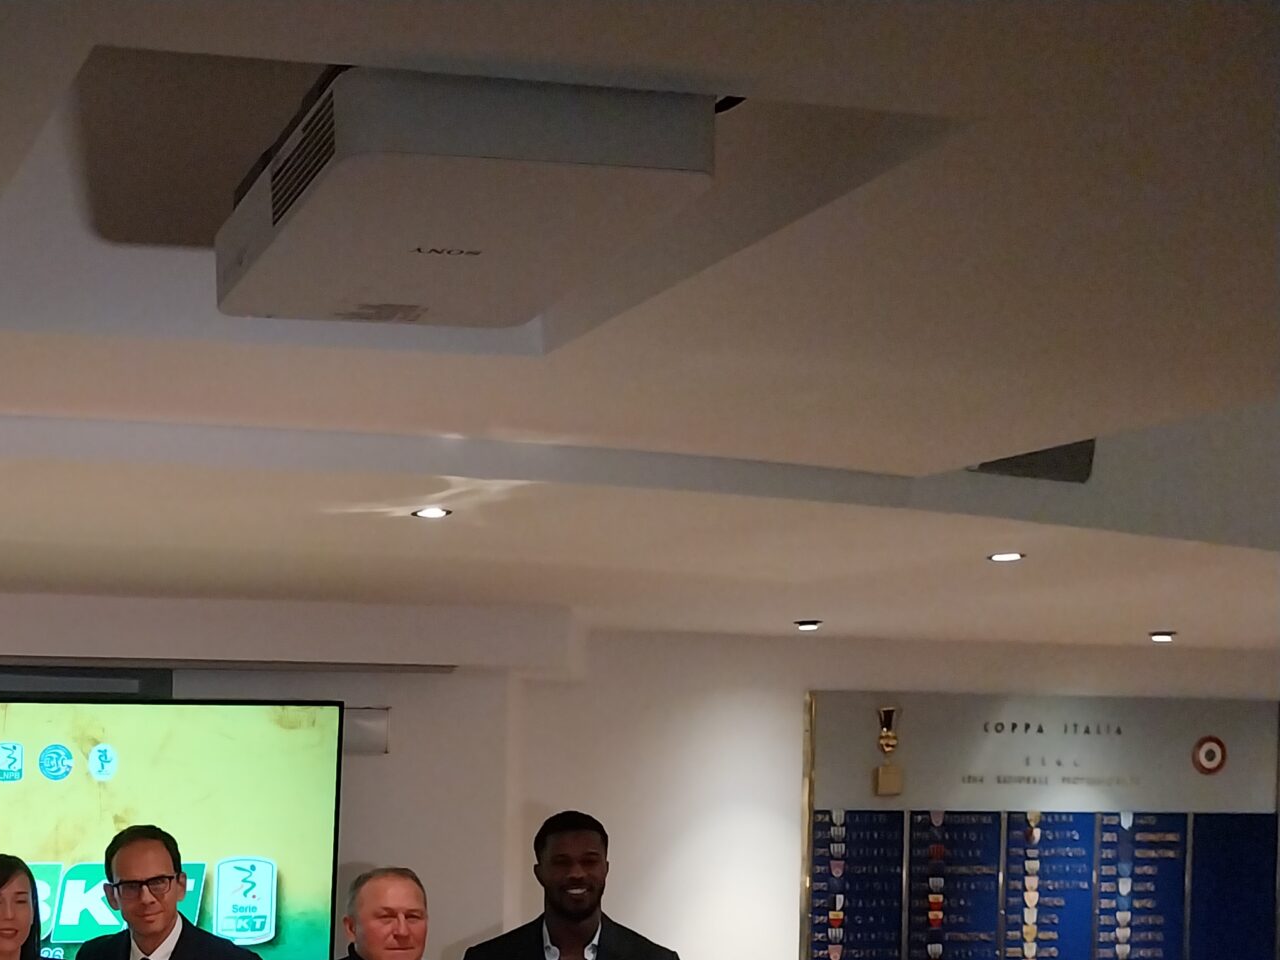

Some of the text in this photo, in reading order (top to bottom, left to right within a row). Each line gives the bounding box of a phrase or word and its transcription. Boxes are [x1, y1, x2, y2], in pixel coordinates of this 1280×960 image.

[407, 246, 483, 257] SONY
[983, 721, 1123, 736] COPPA ITALIA
[231, 904, 258, 914] Serie
